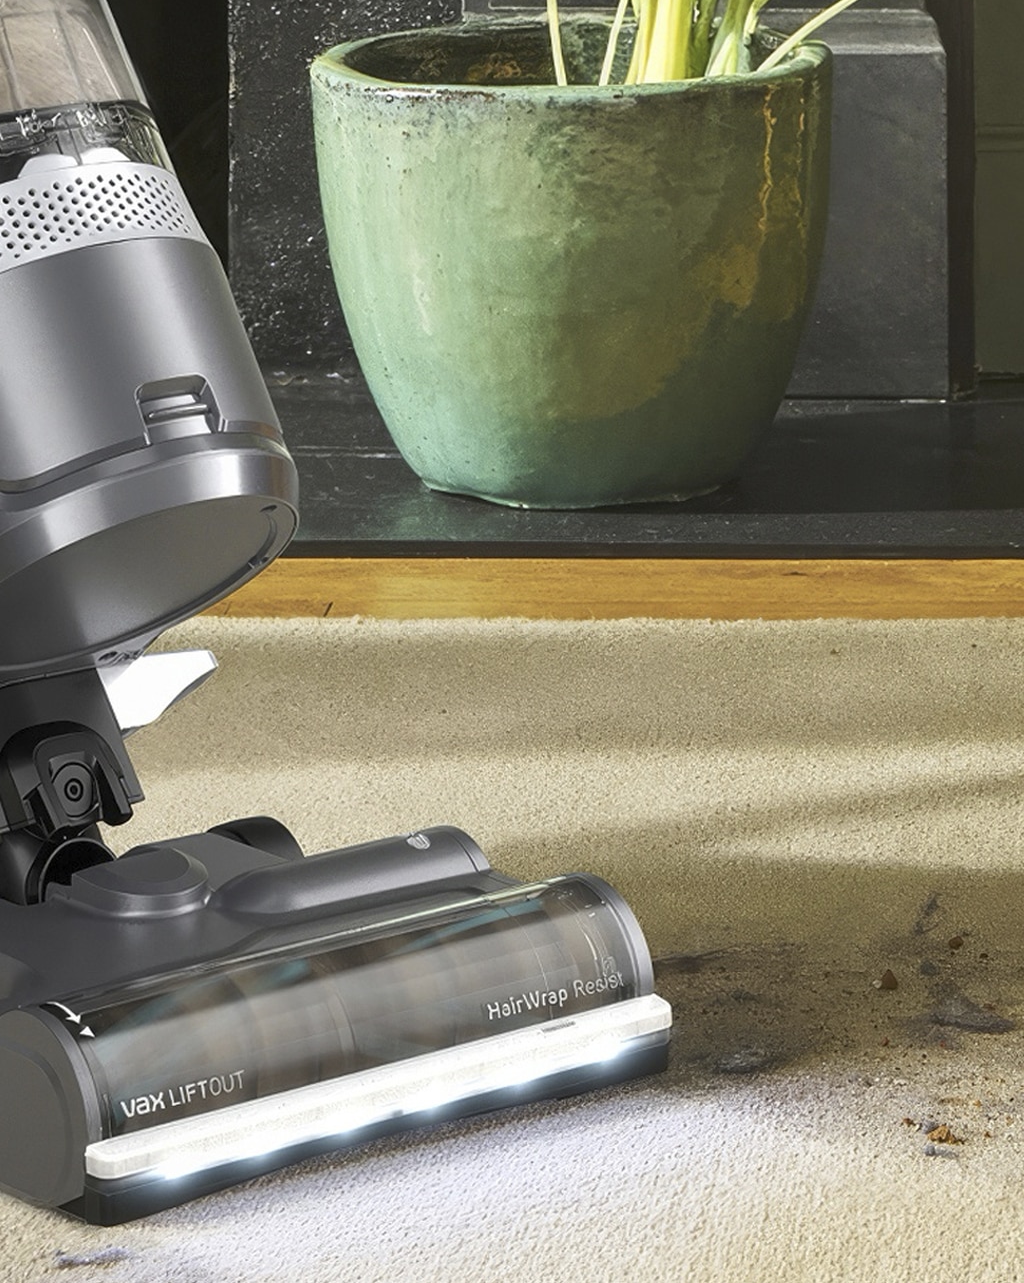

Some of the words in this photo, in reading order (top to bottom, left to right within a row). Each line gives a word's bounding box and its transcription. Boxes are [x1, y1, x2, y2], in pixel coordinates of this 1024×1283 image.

[487, 988, 568, 1020] HairWrap
[120, 1091, 166, 1118] vax
[168, 1069, 245, 1106] LIFTOUT
